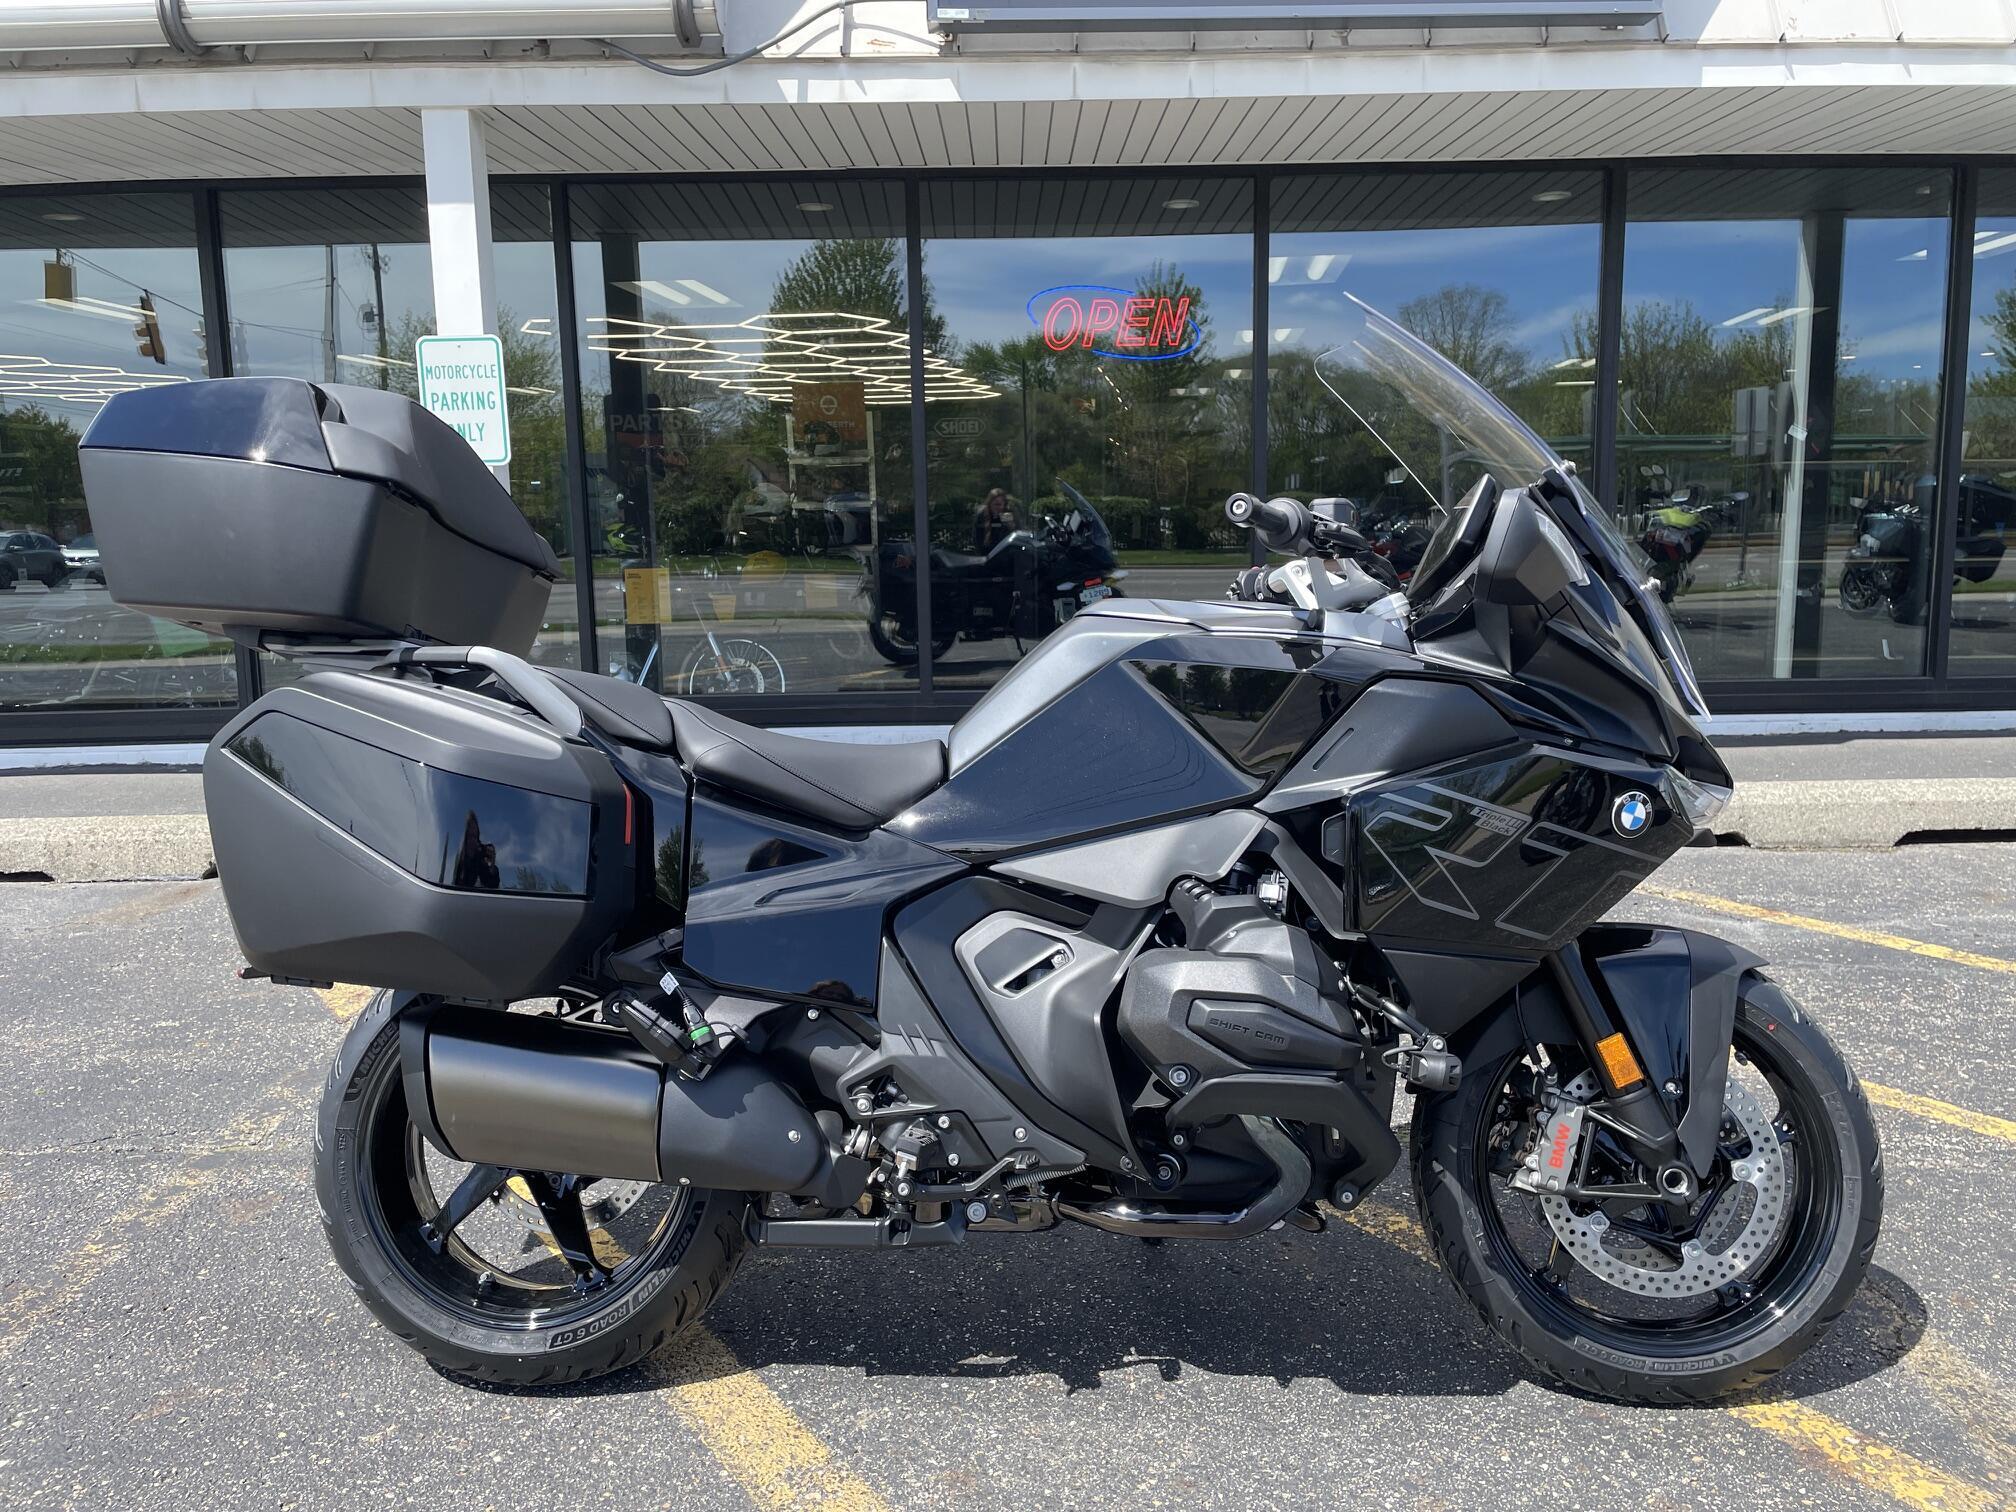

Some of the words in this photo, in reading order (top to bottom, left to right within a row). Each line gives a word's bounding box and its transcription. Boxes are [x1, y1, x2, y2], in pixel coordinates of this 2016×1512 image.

[1044, 297, 1190, 351] OPEN
[425, 364, 497, 380] MOTORCYCLE
[431, 391, 496, 411] PARKING
[446, 422, 485, 442] NLY
[941, 420, 979, 435] SHOEI
[1475, 808, 1507, 824] Triple
[1480, 820, 1513, 835] Black
[1209, 1017, 1250, 1034] SHIFT
[360, 1021, 400, 1075] MICHE
[1548, 1122, 1571, 1169] BMW
[637, 1228, 694, 1303] MICHELIN
[589, 1303, 629, 1333] ROAD
[552, 1333, 573, 1346] GT
[576, 1327, 586, 1336] 6
[1609, 1353, 1643, 1369] ROAD
[1654, 1357, 1715, 1371] MICHELIN
